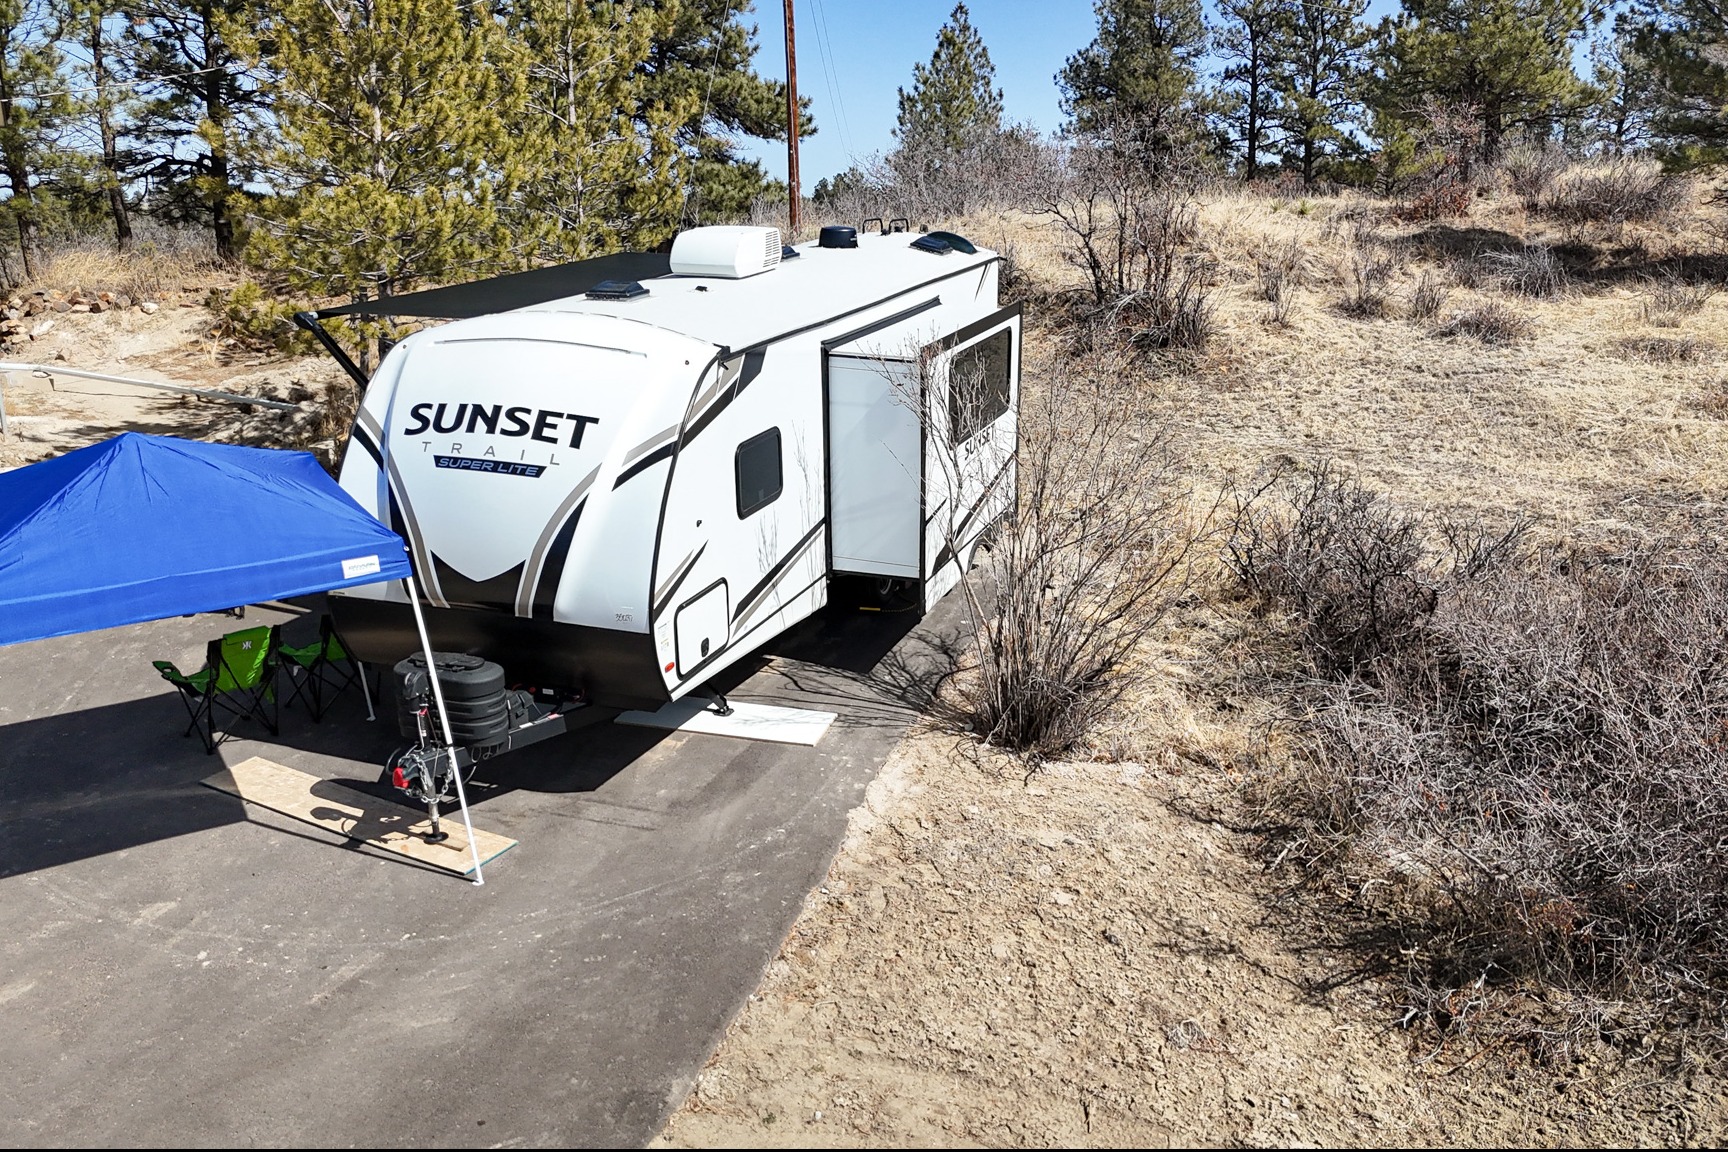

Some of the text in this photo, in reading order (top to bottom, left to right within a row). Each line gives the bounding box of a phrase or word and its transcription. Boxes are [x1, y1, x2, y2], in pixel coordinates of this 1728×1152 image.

[404, 402, 600, 450] SUNSET
[422, 441, 560, 466] TRAIL
[438, 458, 539, 476] SUPER LITE
